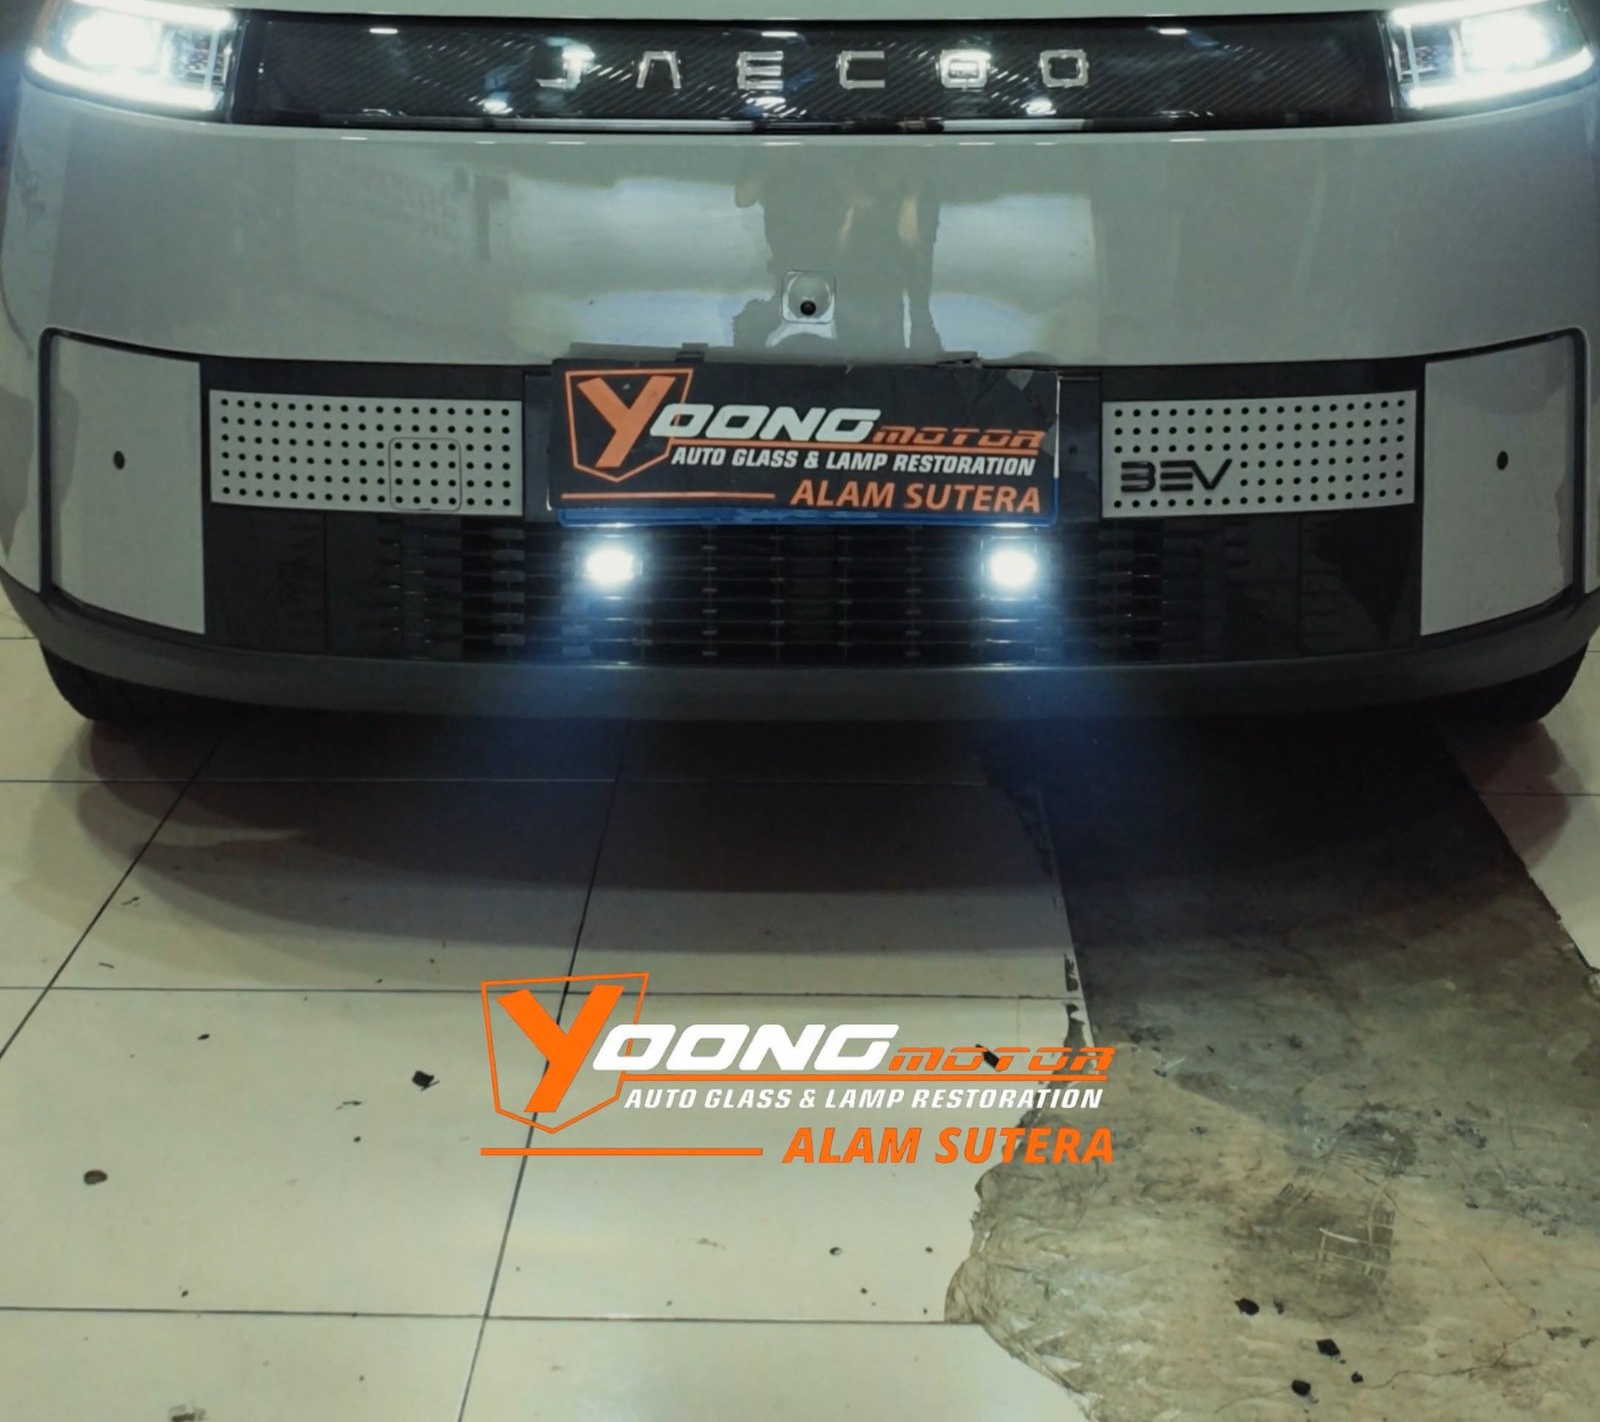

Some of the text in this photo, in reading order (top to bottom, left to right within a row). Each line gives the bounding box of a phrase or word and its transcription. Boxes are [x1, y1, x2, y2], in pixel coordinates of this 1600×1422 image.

[537, 49, 1089, 90] JAECOO
[576, 375, 1046, 468] YOONG MOTOR
[671, 446, 1036, 478] AUTO GLASS & LAMP RESTORATION
[1120, 458, 1233, 493] BEV
[790, 479, 1042, 514] ALAM SUTERA
